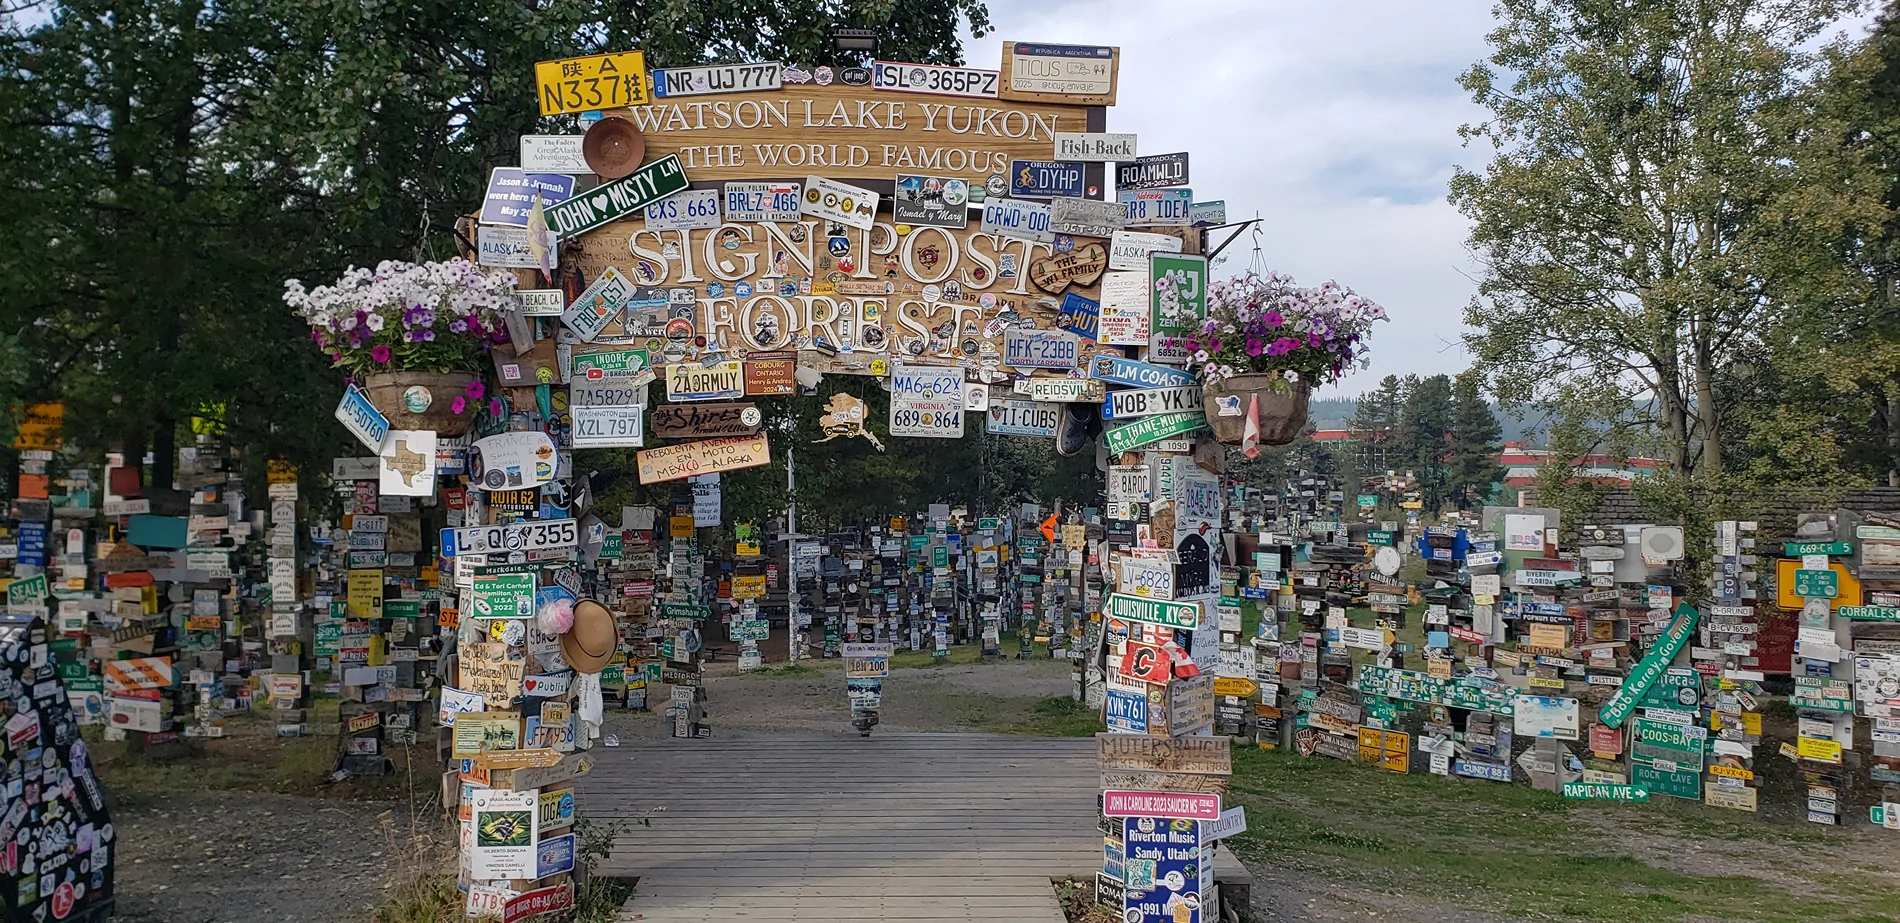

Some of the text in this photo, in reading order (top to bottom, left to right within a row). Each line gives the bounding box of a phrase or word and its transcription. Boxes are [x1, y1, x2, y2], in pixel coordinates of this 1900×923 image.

[1017, 58, 1061, 78] TICUS
[666, 66, 778, 93] NR UJ 777
[884, 65, 997, 95] SL 365PZ
[629, 99, 1059, 142] WATSON LAKE YUKON
[1061, 139, 1132, 155] Fish-Back
[679, 143, 1008, 174] THE WORLD FAMOUS
[1030, 161, 1065, 169] OREGON
[1038, 168, 1078, 190] DYHP
[1121, 162, 1182, 183] ROAMWLD
[497, 178, 520, 186] Jason
[489, 192, 508, 200] were
[510, 192, 529, 201] here
[551, 159, 679, 237] JOHN MISTY LN
[773, 193, 798, 211] 466
[648, 198, 717, 219] CXS 663
[1006, 202, 1037, 210] ONTARIO
[937, 210, 963, 222] Mary
[1194, 211, 1215, 220] KNIGHT
[629, 221, 1053, 295] SIGN POST
[1113, 246, 1145, 258] ALASKA
[1054, 256, 1078, 269] THE
[1060, 264, 1099, 280] FAMILY
[700, 294, 983, 359] FOREST
[596, 353, 626, 364] INDORE
[1158, 349, 1177, 357] 6852
[894, 377, 961, 394] MA6 62X
[1035, 385, 1103, 396] REIDSVILLE
[1114, 389, 1204, 414] WOB YK 14
[578, 419, 636, 435] XZL 797
[895, 410, 959, 428] 689 864
[677, 445, 735, 463] EN MOTO
[521, 491, 534, 504] 62
[534, 523, 574, 545] 355
[1140, 571, 1170, 589] 6828
[1585, 592, 1617, 600] NEUFFEN
[667, 607, 699, 617] Grimshaw
[1114, 595, 1178, 623] LOUISVILLE, KY
[1840, 607, 1894, 618] CORRALES
[870, 662, 884, 671] 100
[1612, 614, 1692, 718] Bob Kerrey, Governor
[538, 682, 564, 692] Publix
[1365, 673, 1390, 692] Jan
[1399, 681, 1438, 698] Lake
[1463, 691, 1479, 702] km
[1796, 678, 1848, 688] LEADORE IDAHO
[1363, 697, 1375, 705] ASH
[1806, 699, 1839, 709] RICHMOND
[1642, 729, 1692, 746] COOS BAY
[1463, 764, 1490, 776] CUNDY
[1639, 769, 1692, 784] ROCK CAVE
[1563, 784, 1633, 799] RAPIDAN AVE
[1109, 796, 1197, 813] JOHN & CAROLINE 2023 SAUCIER MS
[1212, 813, 1243, 833] COUNTRY
[1129, 829, 1195, 844] Riverton Music
[1136, 846, 1189, 861] Sandy, Utah
[1140, 902, 1160, 915] 1991
